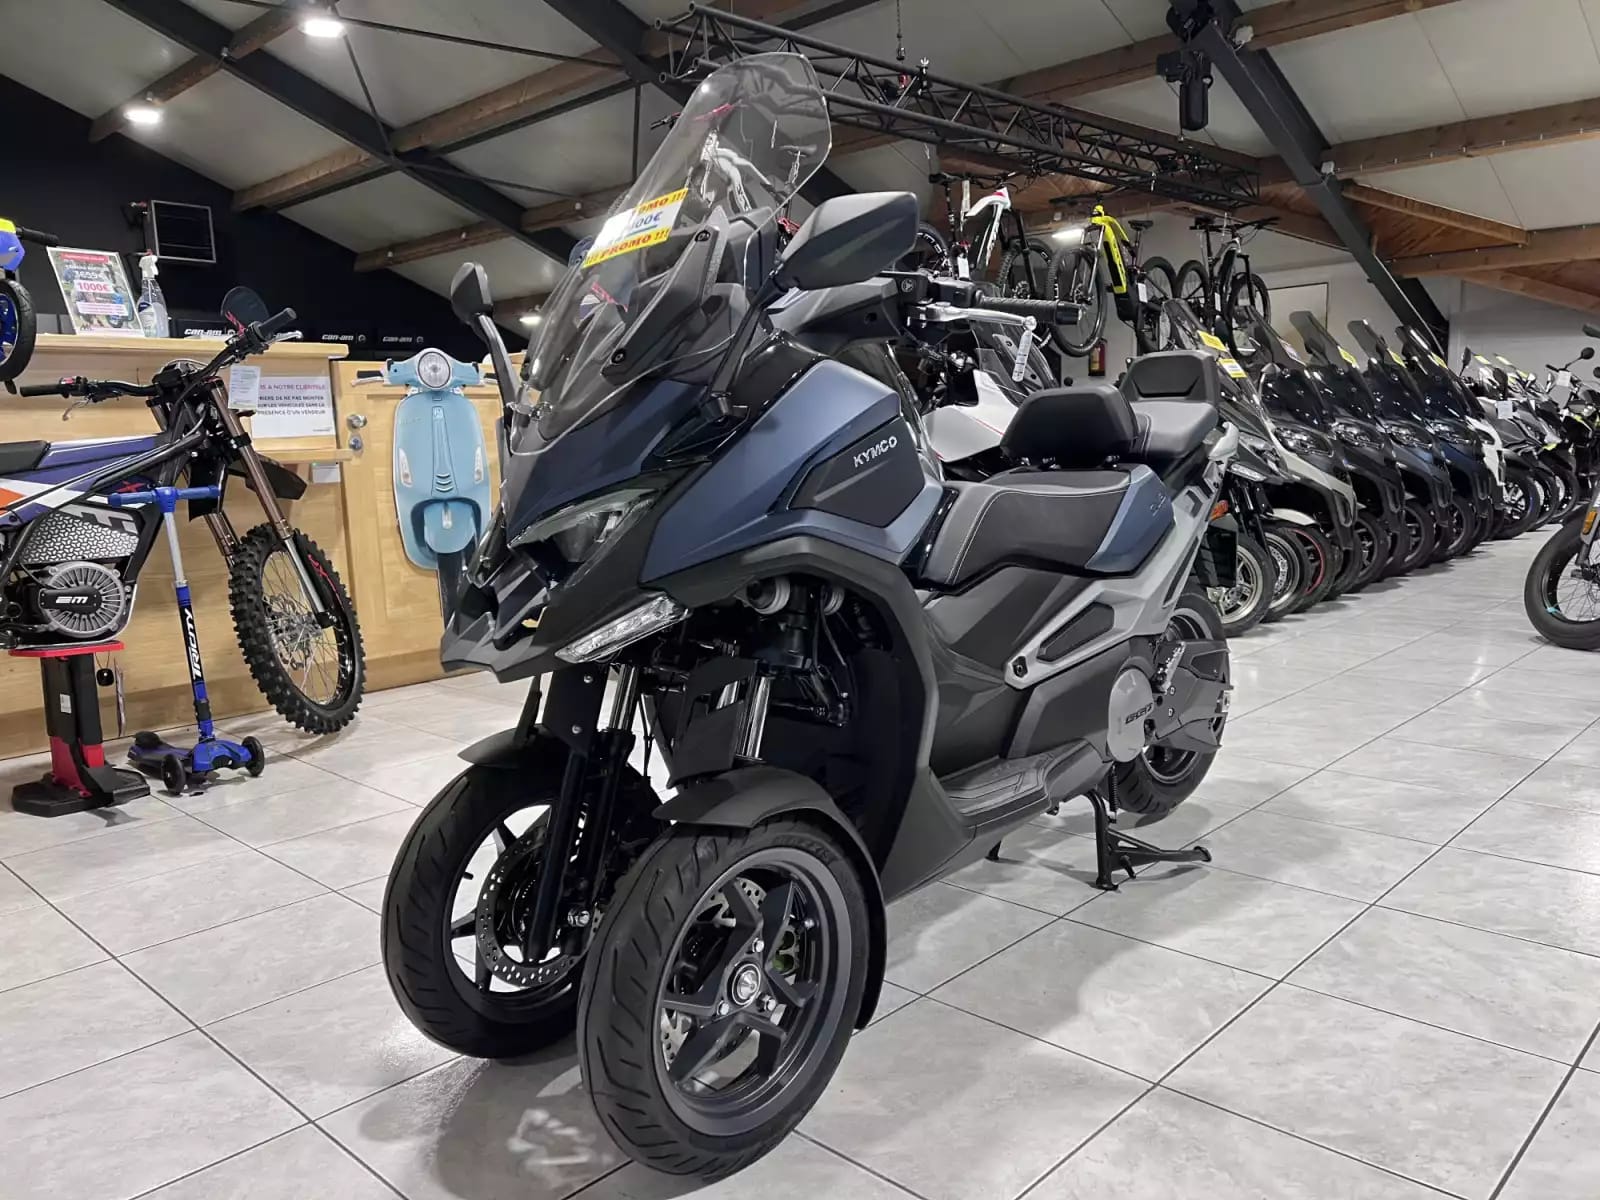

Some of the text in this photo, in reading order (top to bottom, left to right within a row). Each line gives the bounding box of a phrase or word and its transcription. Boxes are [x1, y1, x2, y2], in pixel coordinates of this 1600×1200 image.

[78, 283, 109, 292] 1000€
[853, 435, 898, 468] KYMCO
[184, 608, 202, 680] TRICITY
